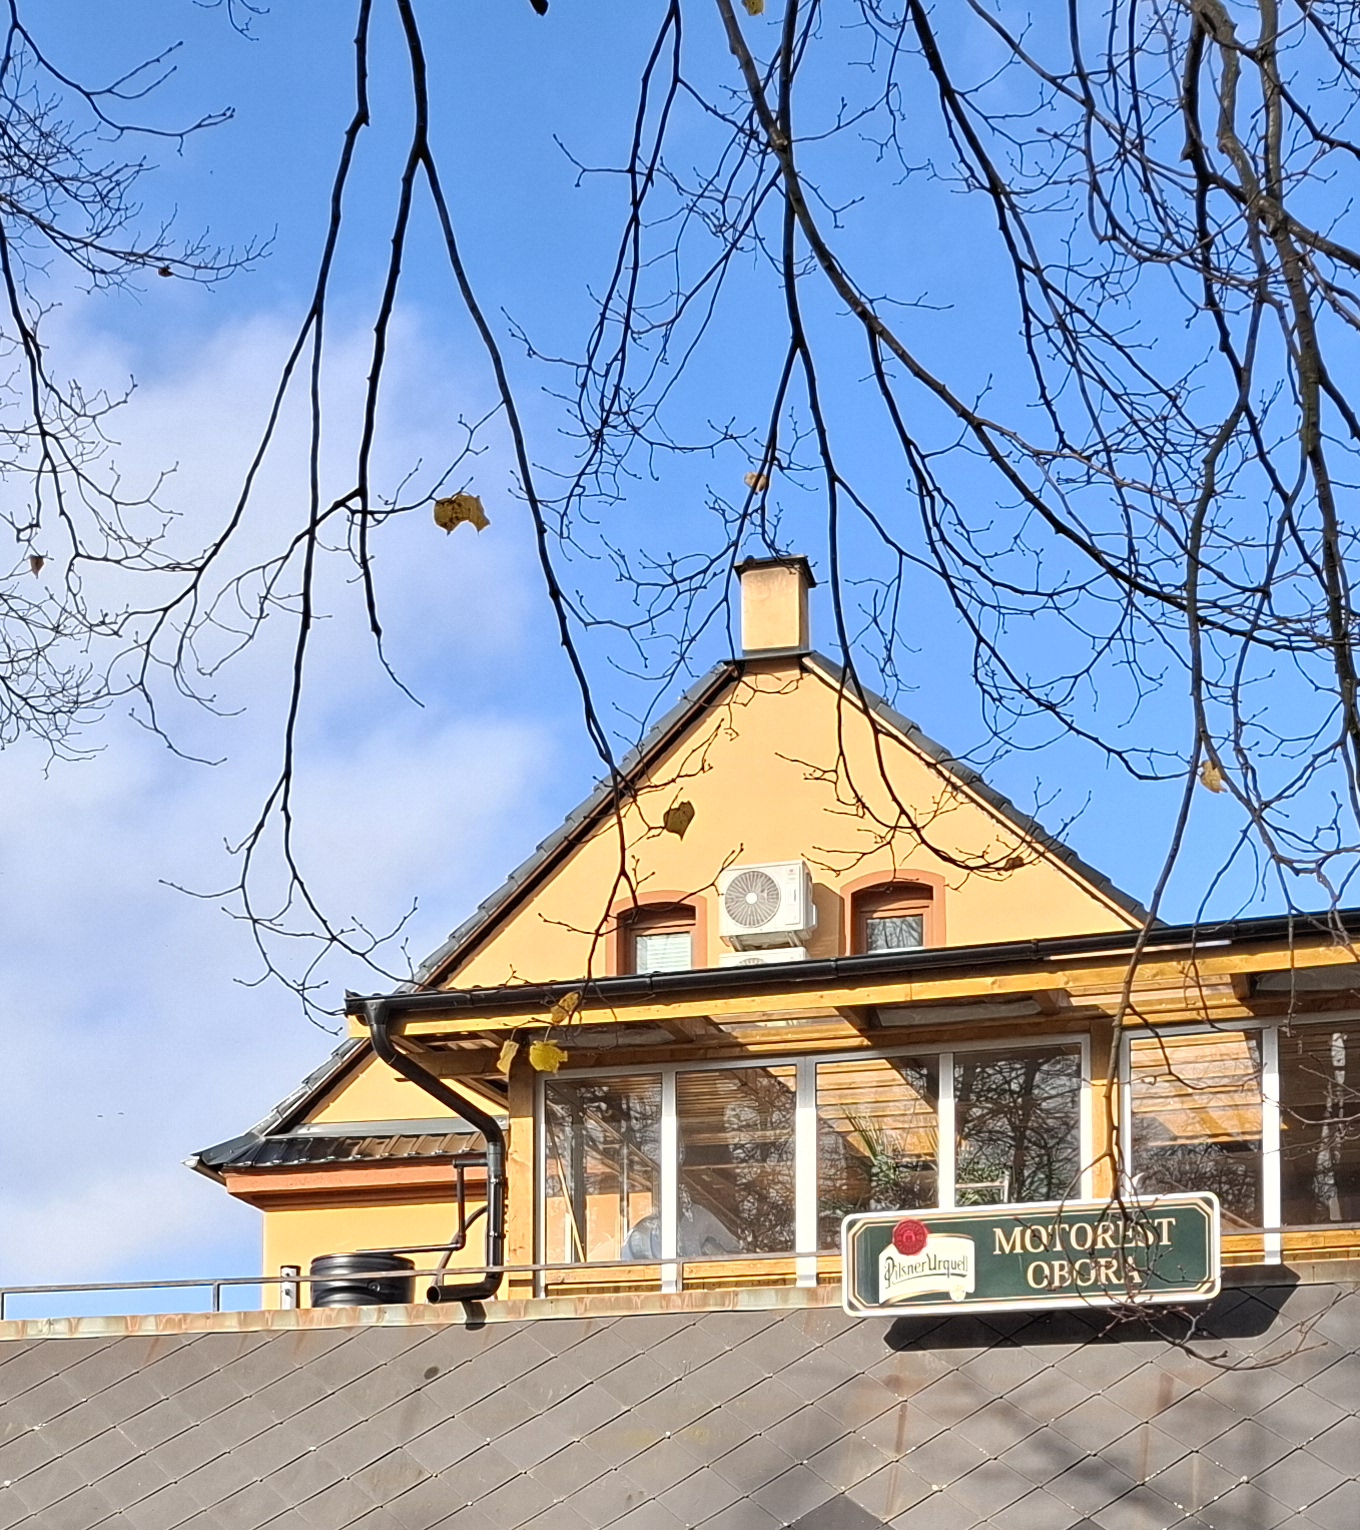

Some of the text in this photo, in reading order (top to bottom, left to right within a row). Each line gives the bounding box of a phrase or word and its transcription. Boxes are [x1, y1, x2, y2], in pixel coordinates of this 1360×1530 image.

[992, 1217, 1176, 1255] MOTOREST
[883, 1253, 968, 1289] Pilsner Urquell
[1026, 1256, 1143, 1289] OBORA
